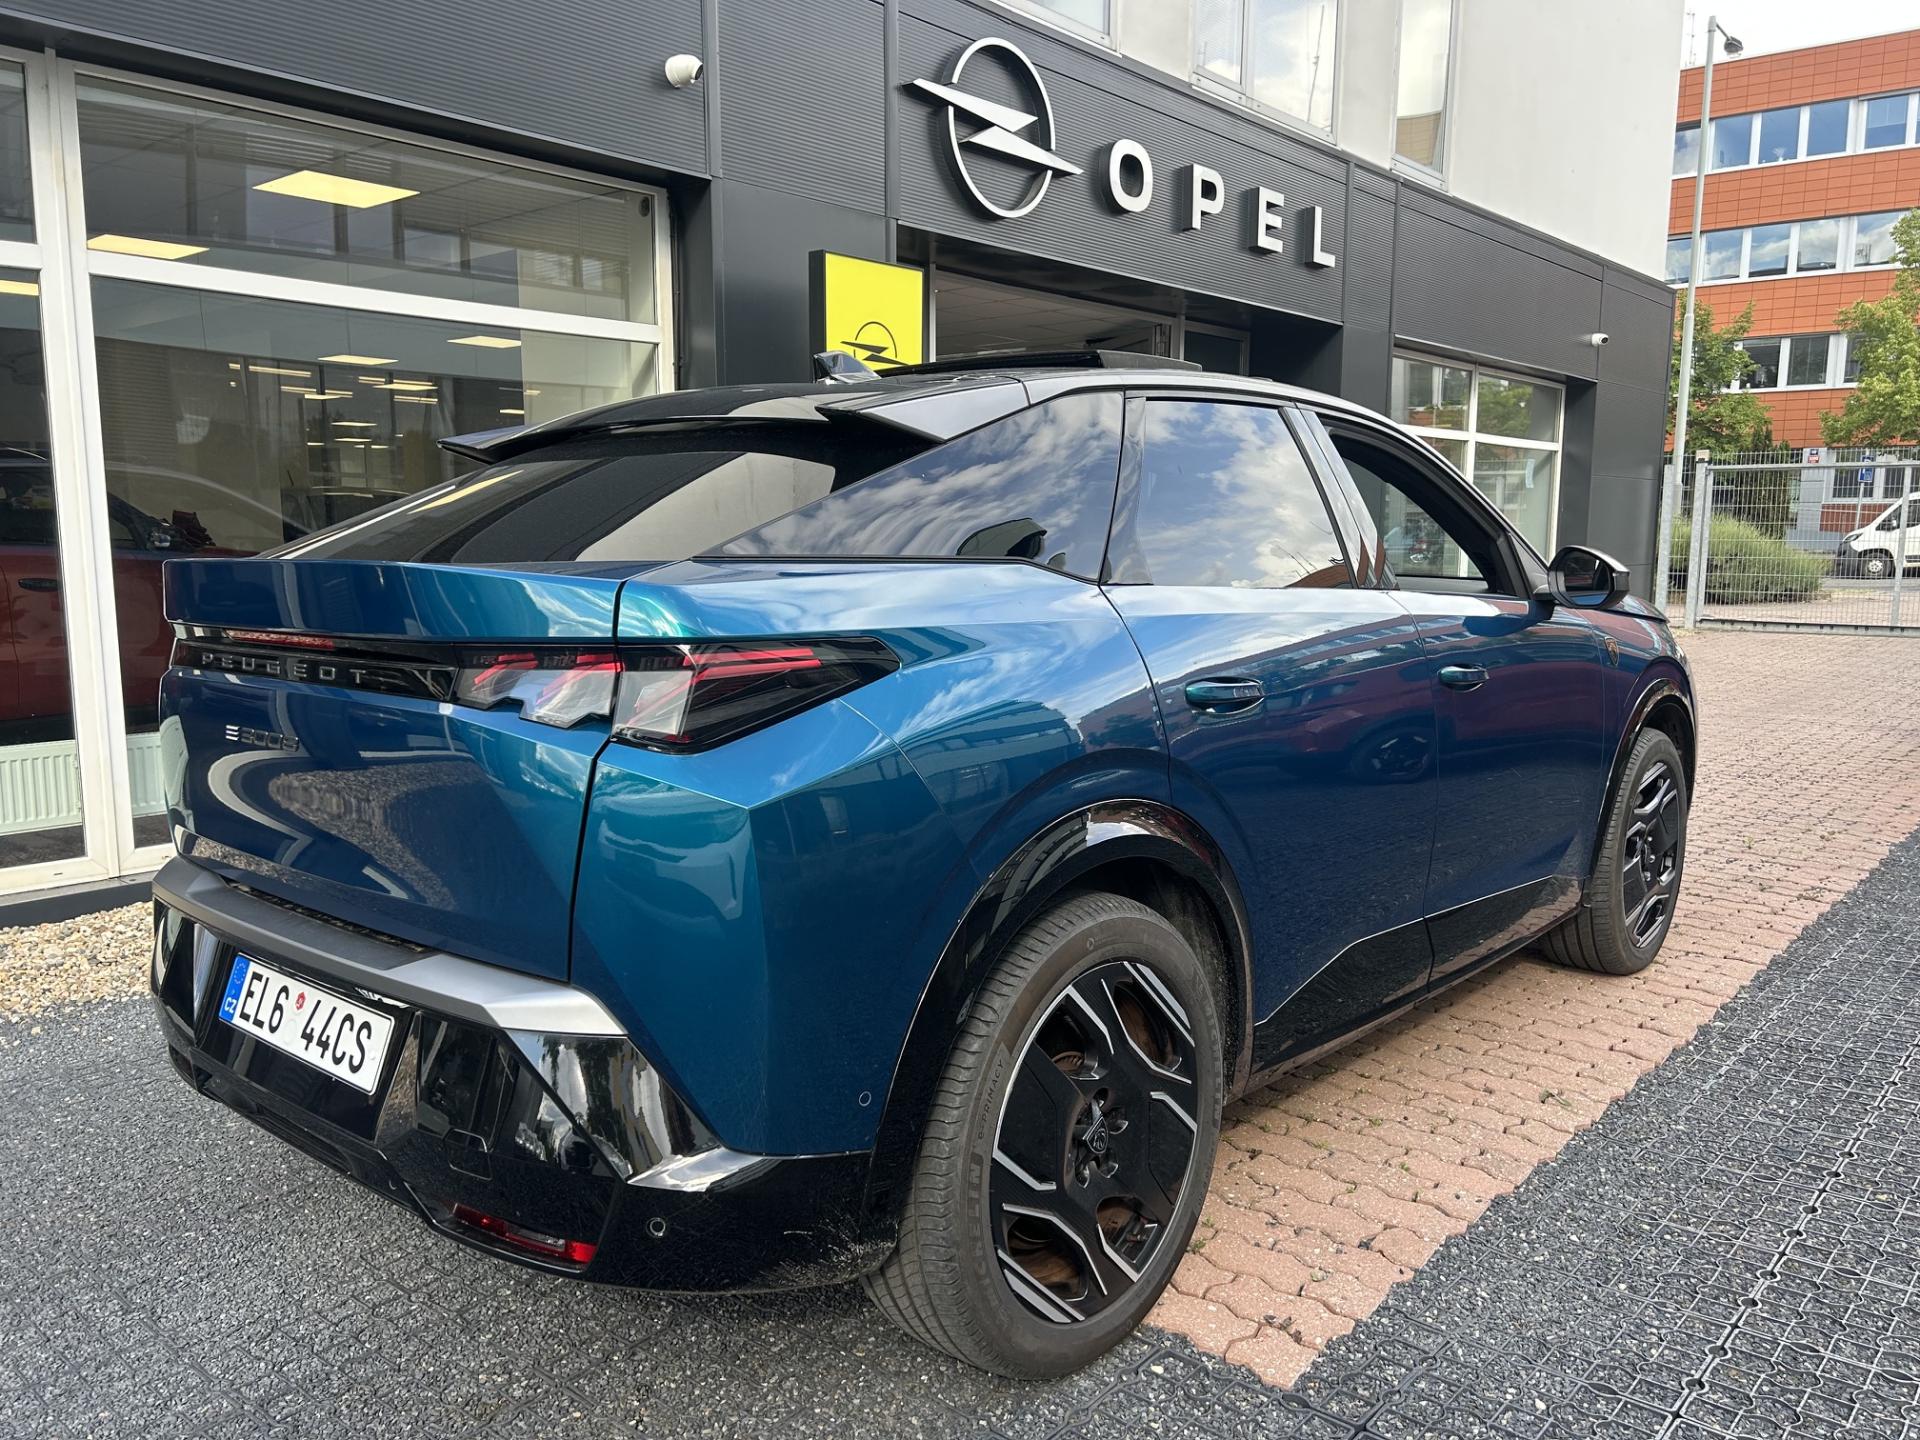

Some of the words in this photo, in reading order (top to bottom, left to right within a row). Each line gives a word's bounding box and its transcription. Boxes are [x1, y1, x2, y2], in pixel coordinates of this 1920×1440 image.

[1102, 138, 1336, 268] OPEL
[202, 652, 366, 684] PEUGEOT
[224, 997, 238, 1013] CZ
[239, 971, 290, 1034] EL6
[300, 999, 372, 1074] 44CS
